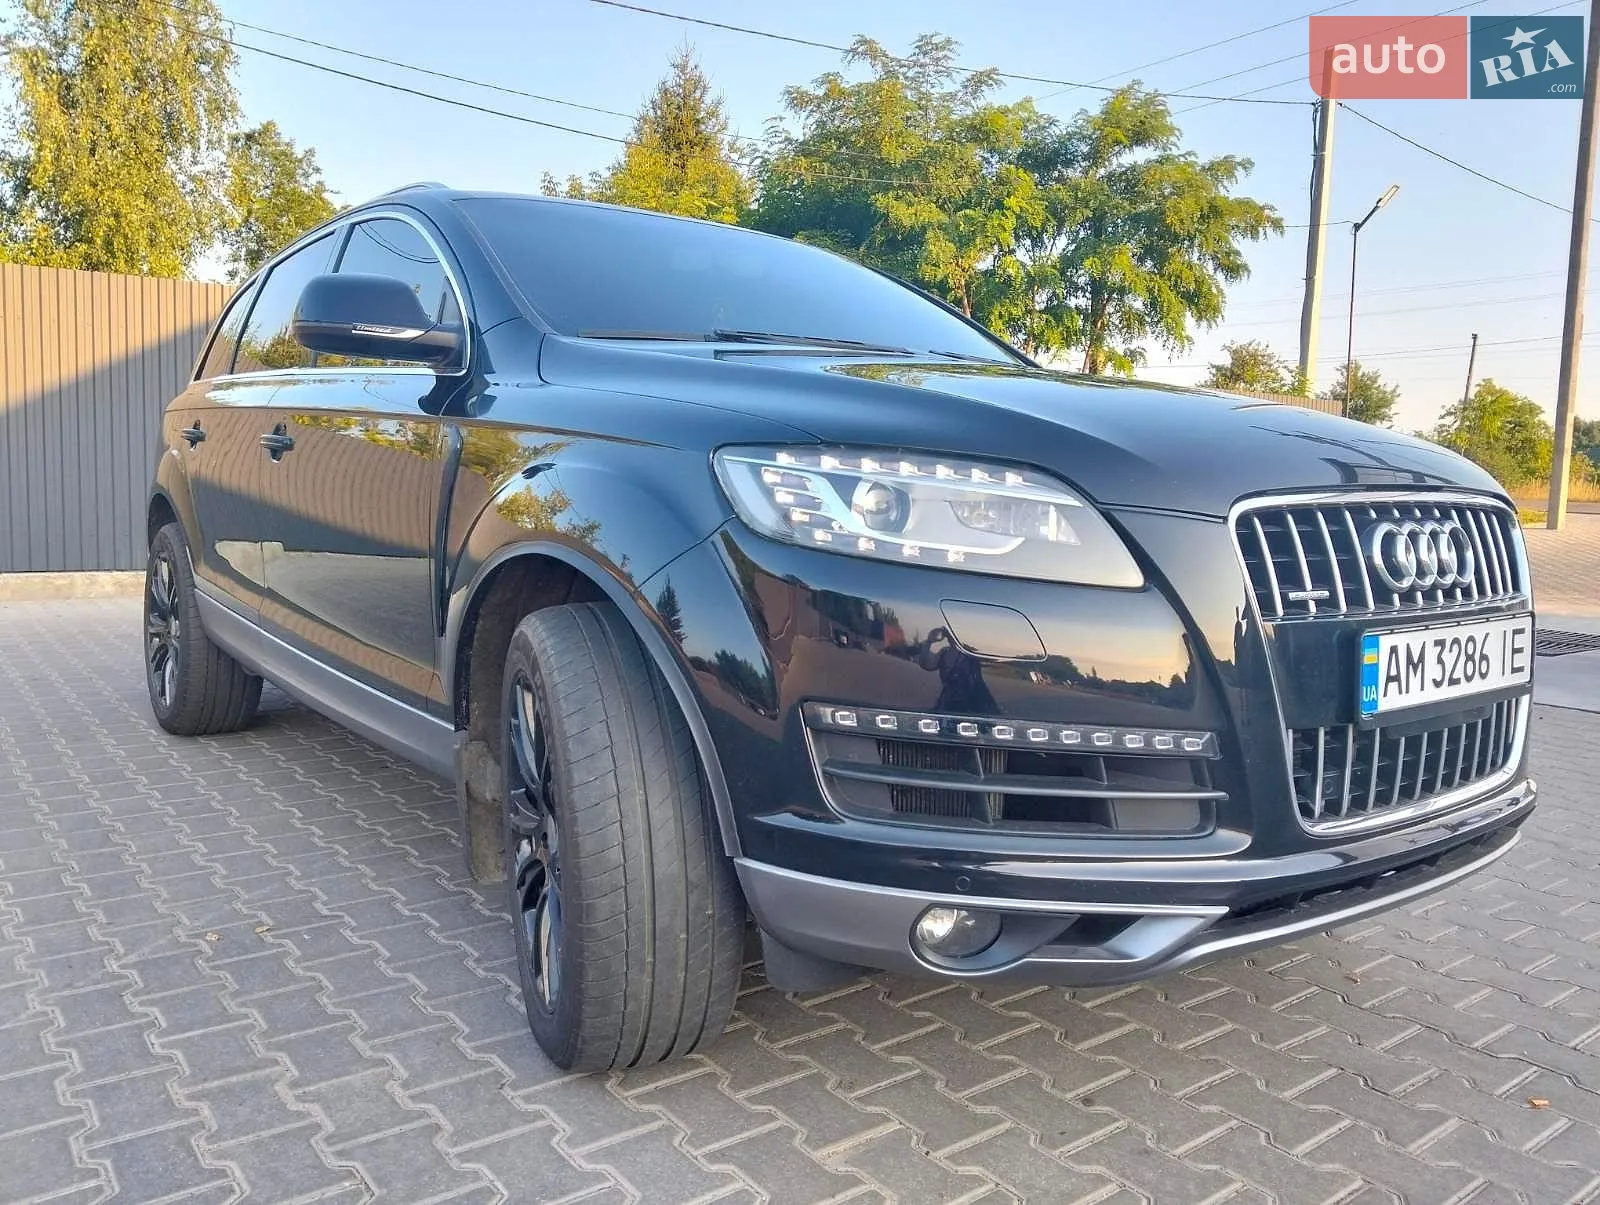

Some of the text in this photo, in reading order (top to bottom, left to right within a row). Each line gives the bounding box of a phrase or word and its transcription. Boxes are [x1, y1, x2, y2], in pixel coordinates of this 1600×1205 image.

[1383, 628, 1527, 698] AM 3286 IE
[1363, 686, 1378, 702] UA
